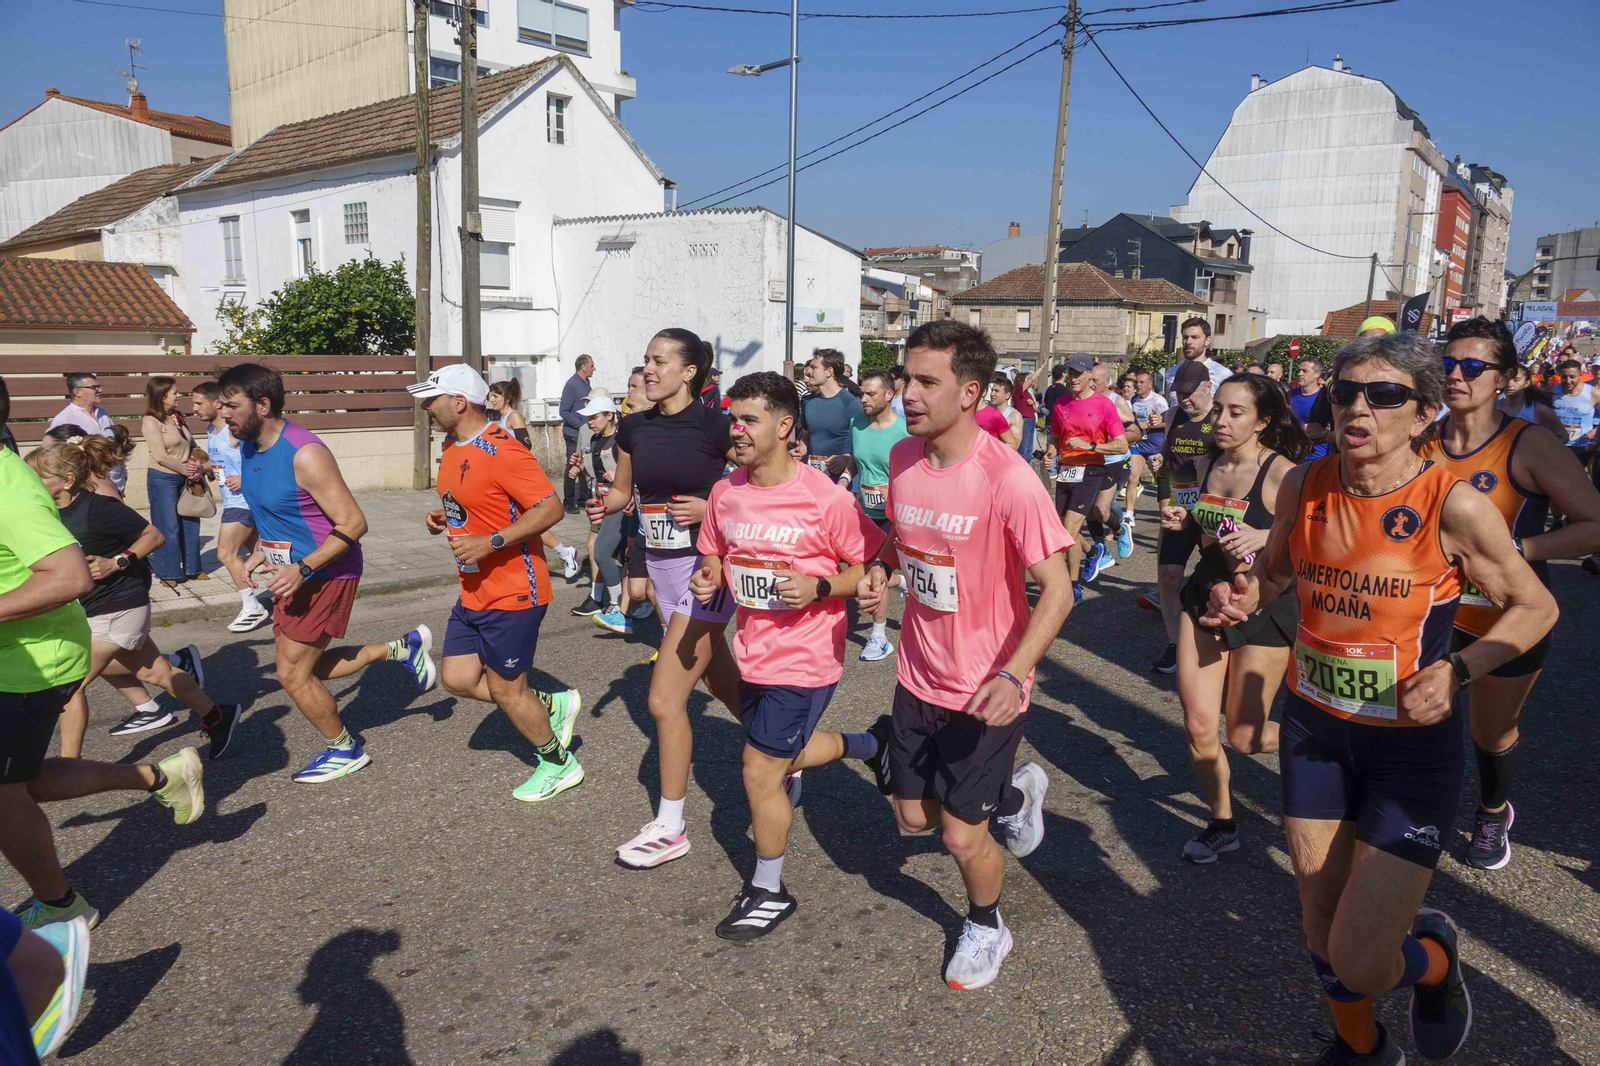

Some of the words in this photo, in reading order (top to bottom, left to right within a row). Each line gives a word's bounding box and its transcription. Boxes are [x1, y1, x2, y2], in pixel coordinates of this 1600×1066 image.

[1175, 437, 1204, 447] Floristería
[1063, 468, 1077, 479] 719
[1178, 491, 1198, 505] 323
[650, 520, 675, 540] 572
[741, 573, 780, 600] 1084
[907, 563, 938, 598] 754
[1297, 558, 1411, 599] SAMERTOLAMEU
[1311, 590, 1372, 621] MOAÑA
[1323, 655, 1348, 666] ELENA
[1304, 654, 1379, 702] 2038
